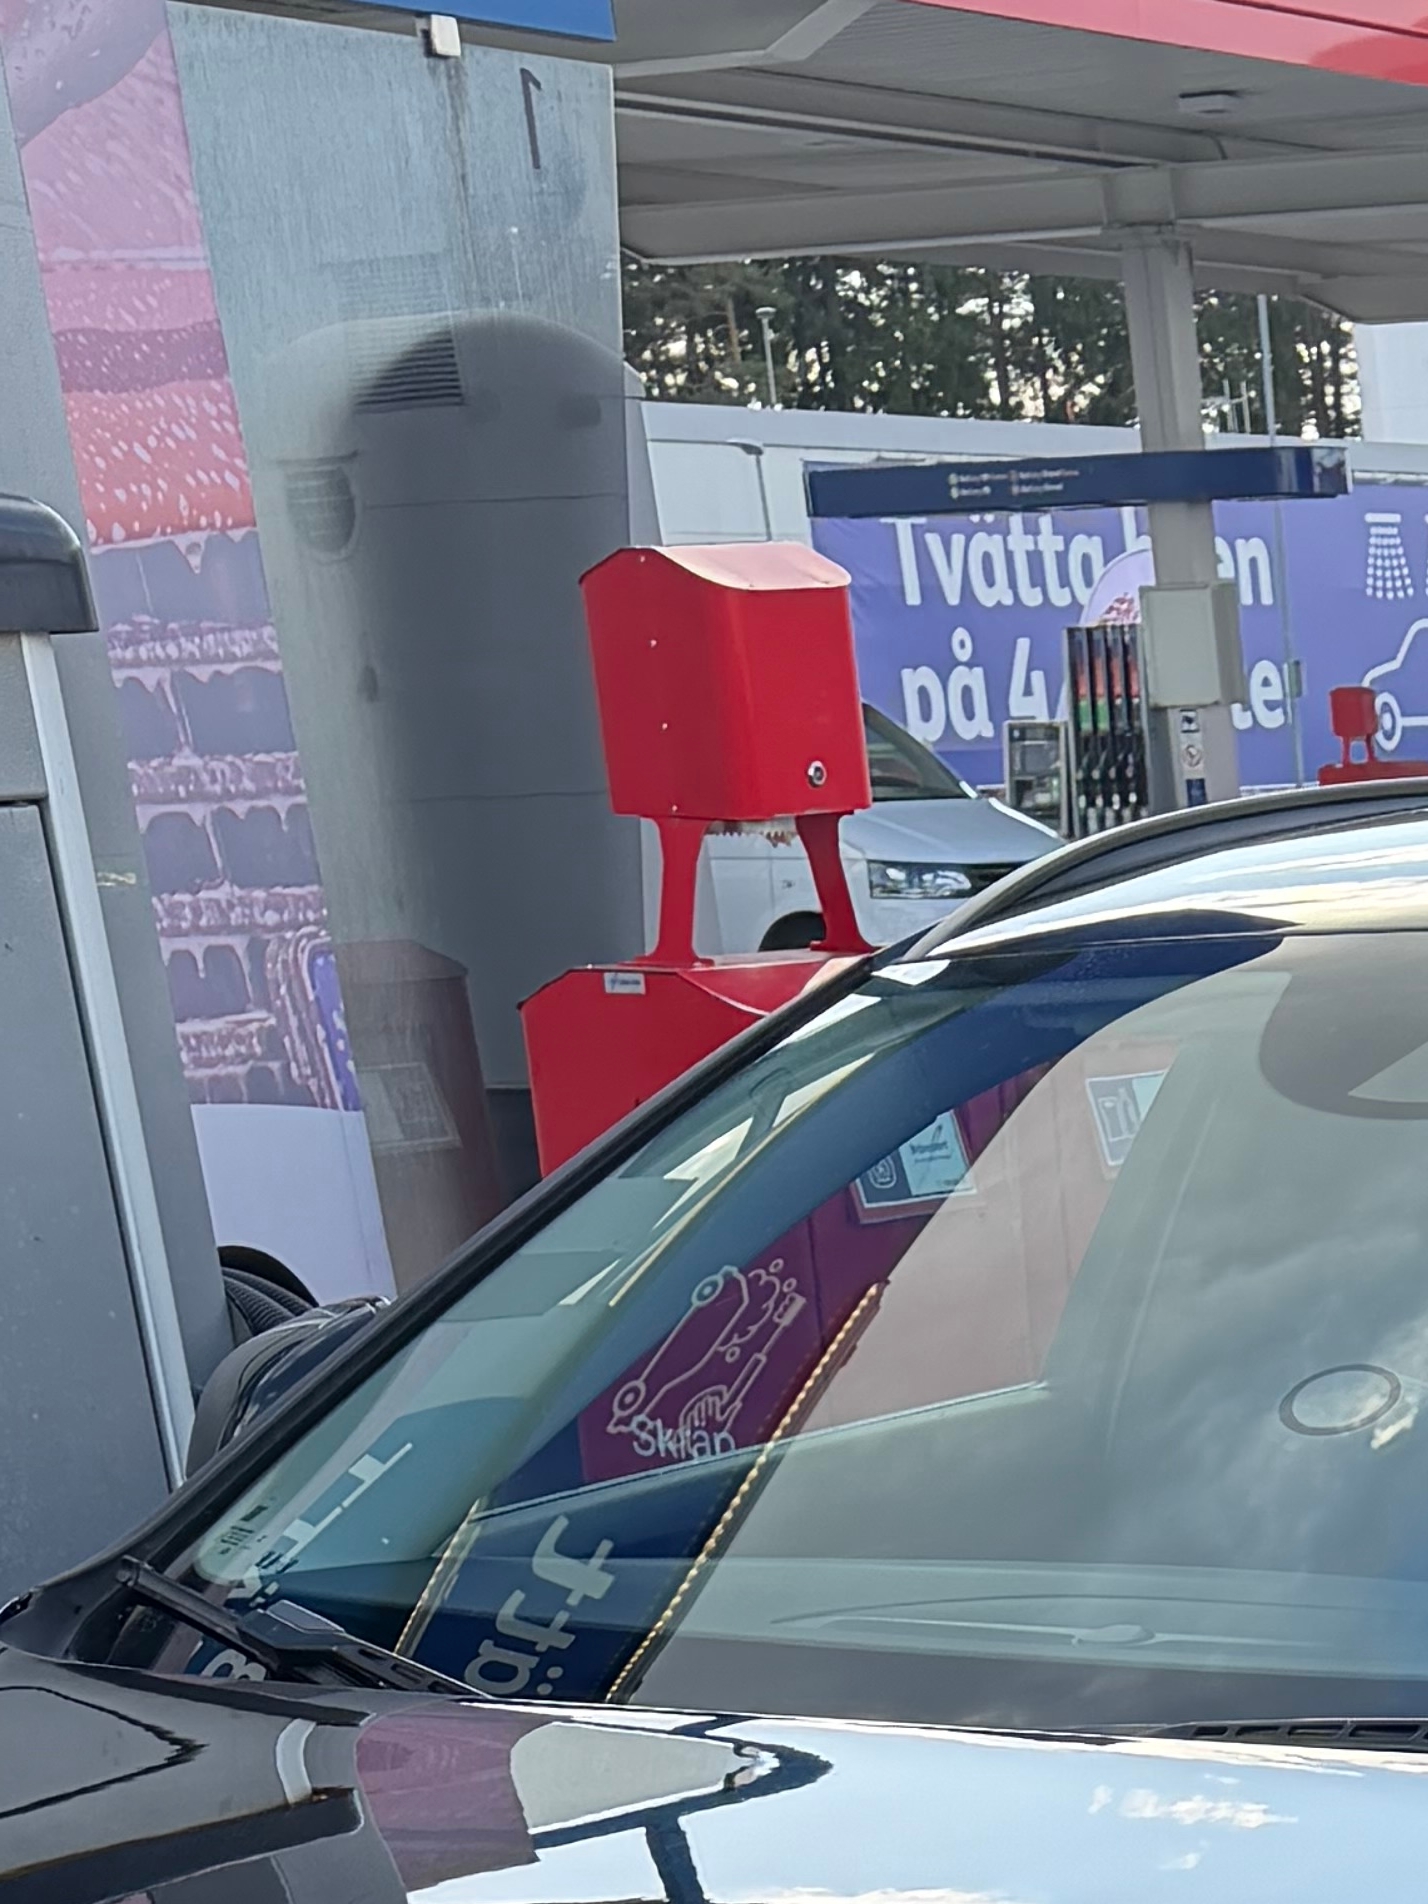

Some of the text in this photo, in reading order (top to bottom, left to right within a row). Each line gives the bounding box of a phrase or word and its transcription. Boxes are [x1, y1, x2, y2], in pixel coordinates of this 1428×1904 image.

[880, 513, 1104, 607] Tvätta
[900, 626, 995, 741] på
[1008, 637, 1050, 720] 4
